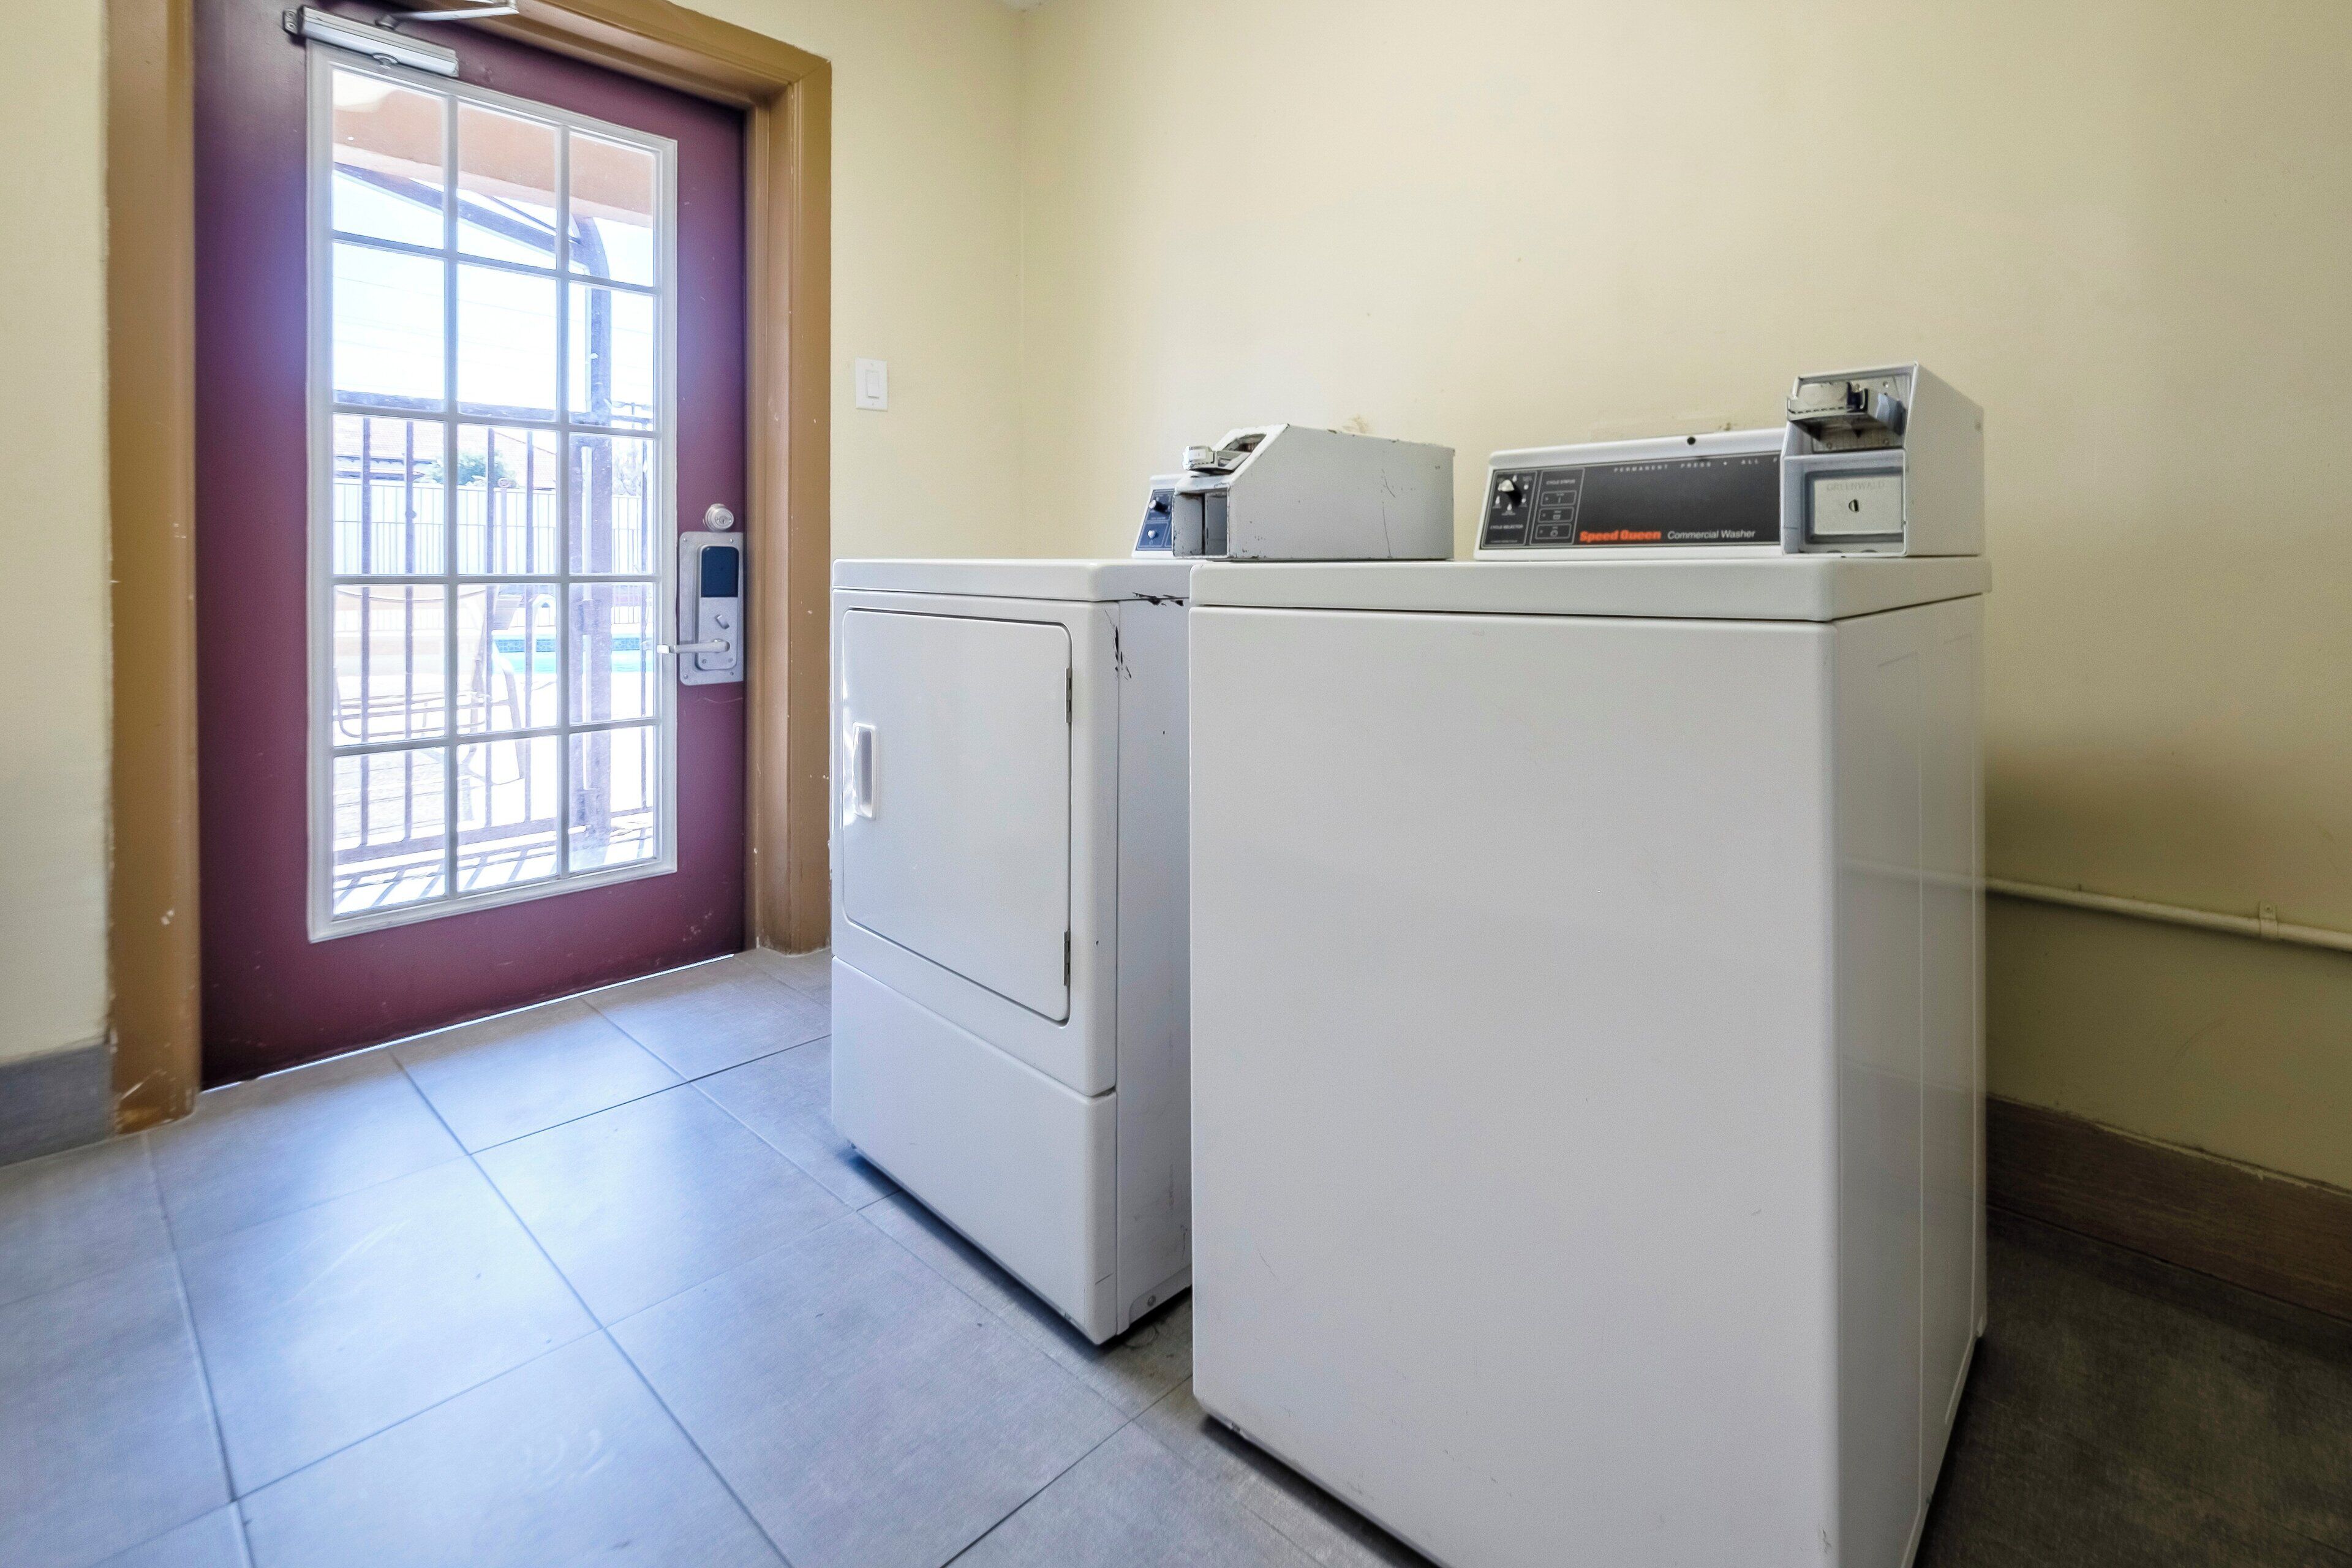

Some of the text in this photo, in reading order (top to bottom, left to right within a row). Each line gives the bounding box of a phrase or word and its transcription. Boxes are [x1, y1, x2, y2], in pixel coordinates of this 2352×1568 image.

[1613, 464, 1668, 472] PERMANENT
[1580, 530, 1756, 543] Speed Queen Commercial Washer
